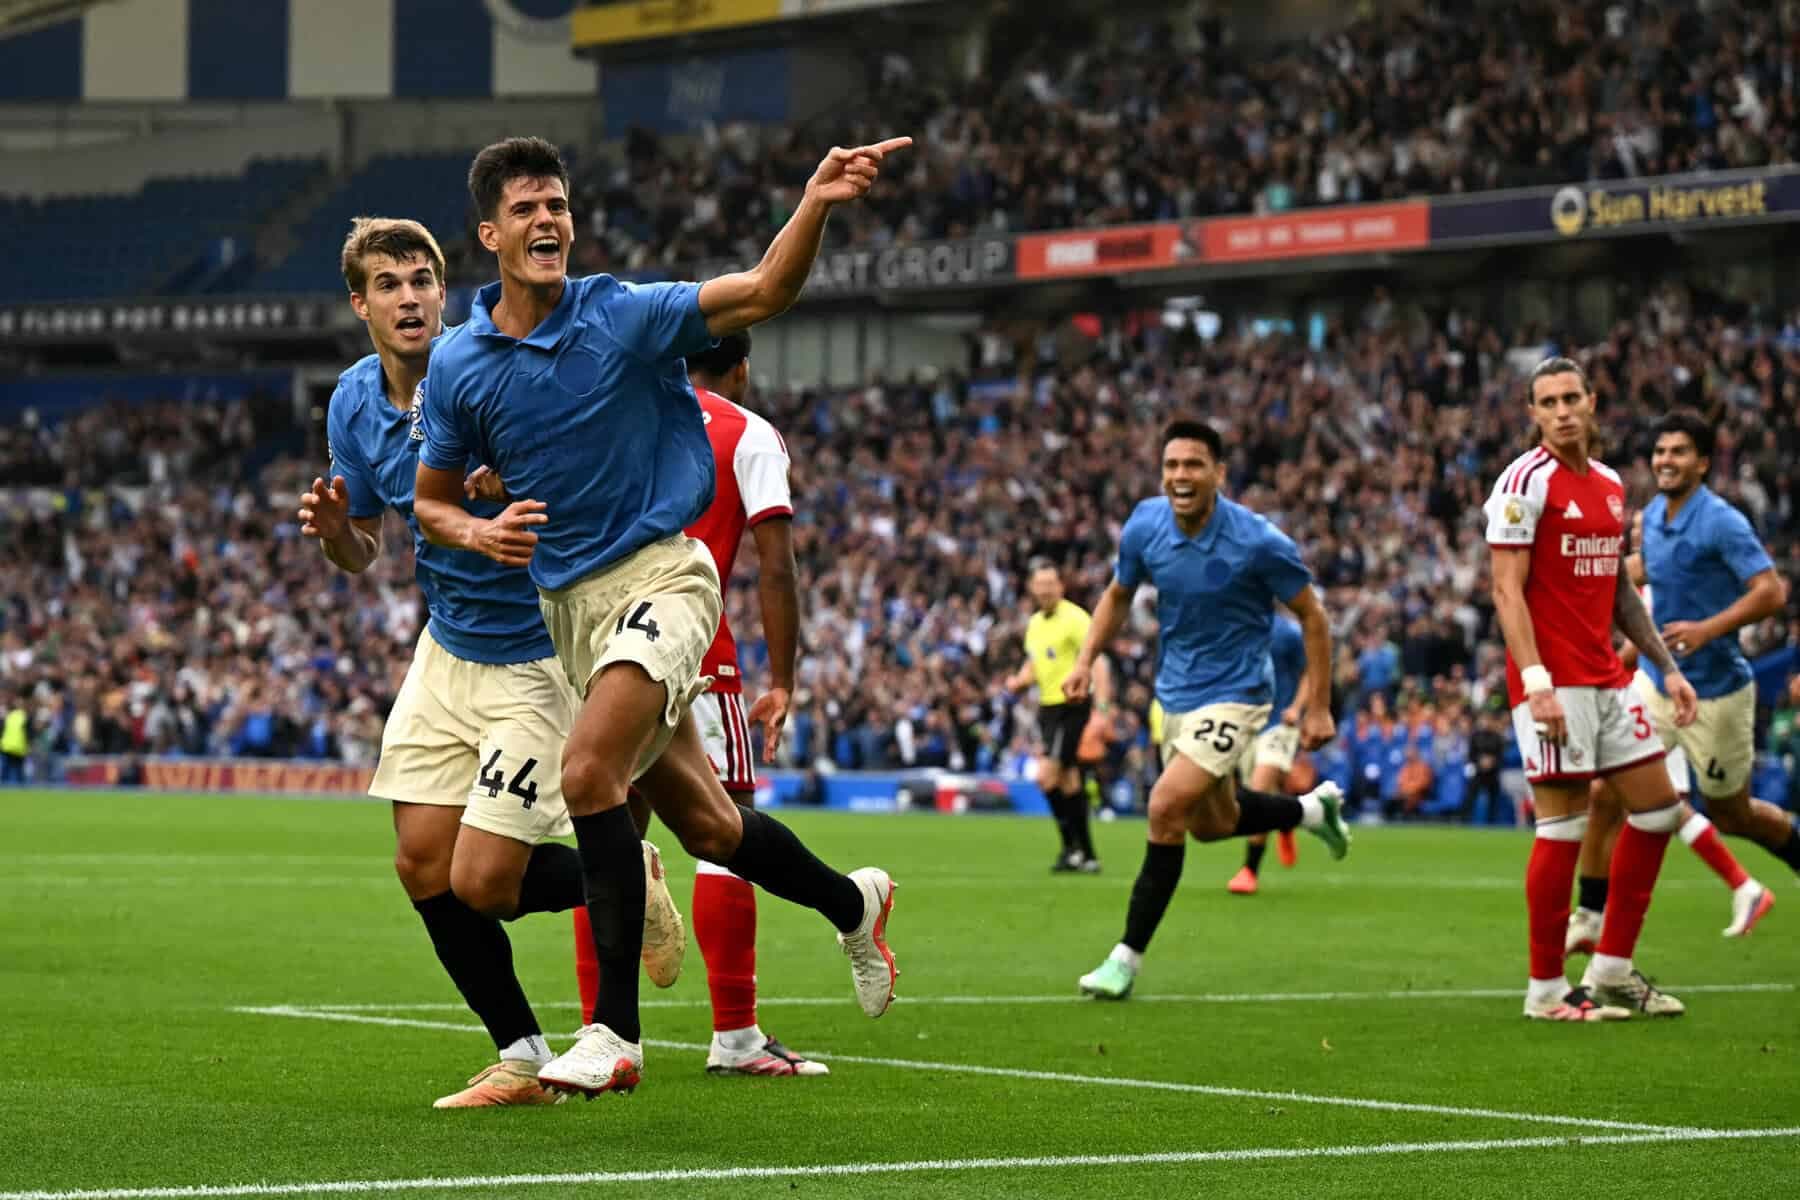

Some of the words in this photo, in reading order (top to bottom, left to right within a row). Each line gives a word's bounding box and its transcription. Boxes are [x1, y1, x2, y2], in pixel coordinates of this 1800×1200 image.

[1589, 190, 1644, 227] Sun
[1649, 179, 1766, 221] Harvest
[877, 240, 1007, 288] GROUP
[1560, 533, 1624, 557] Emirat
[616, 601, 660, 642] 14
[1192, 718, 1240, 753] 25
[478, 749, 538, 810] 44
[1706, 757, 1727, 781] 4
